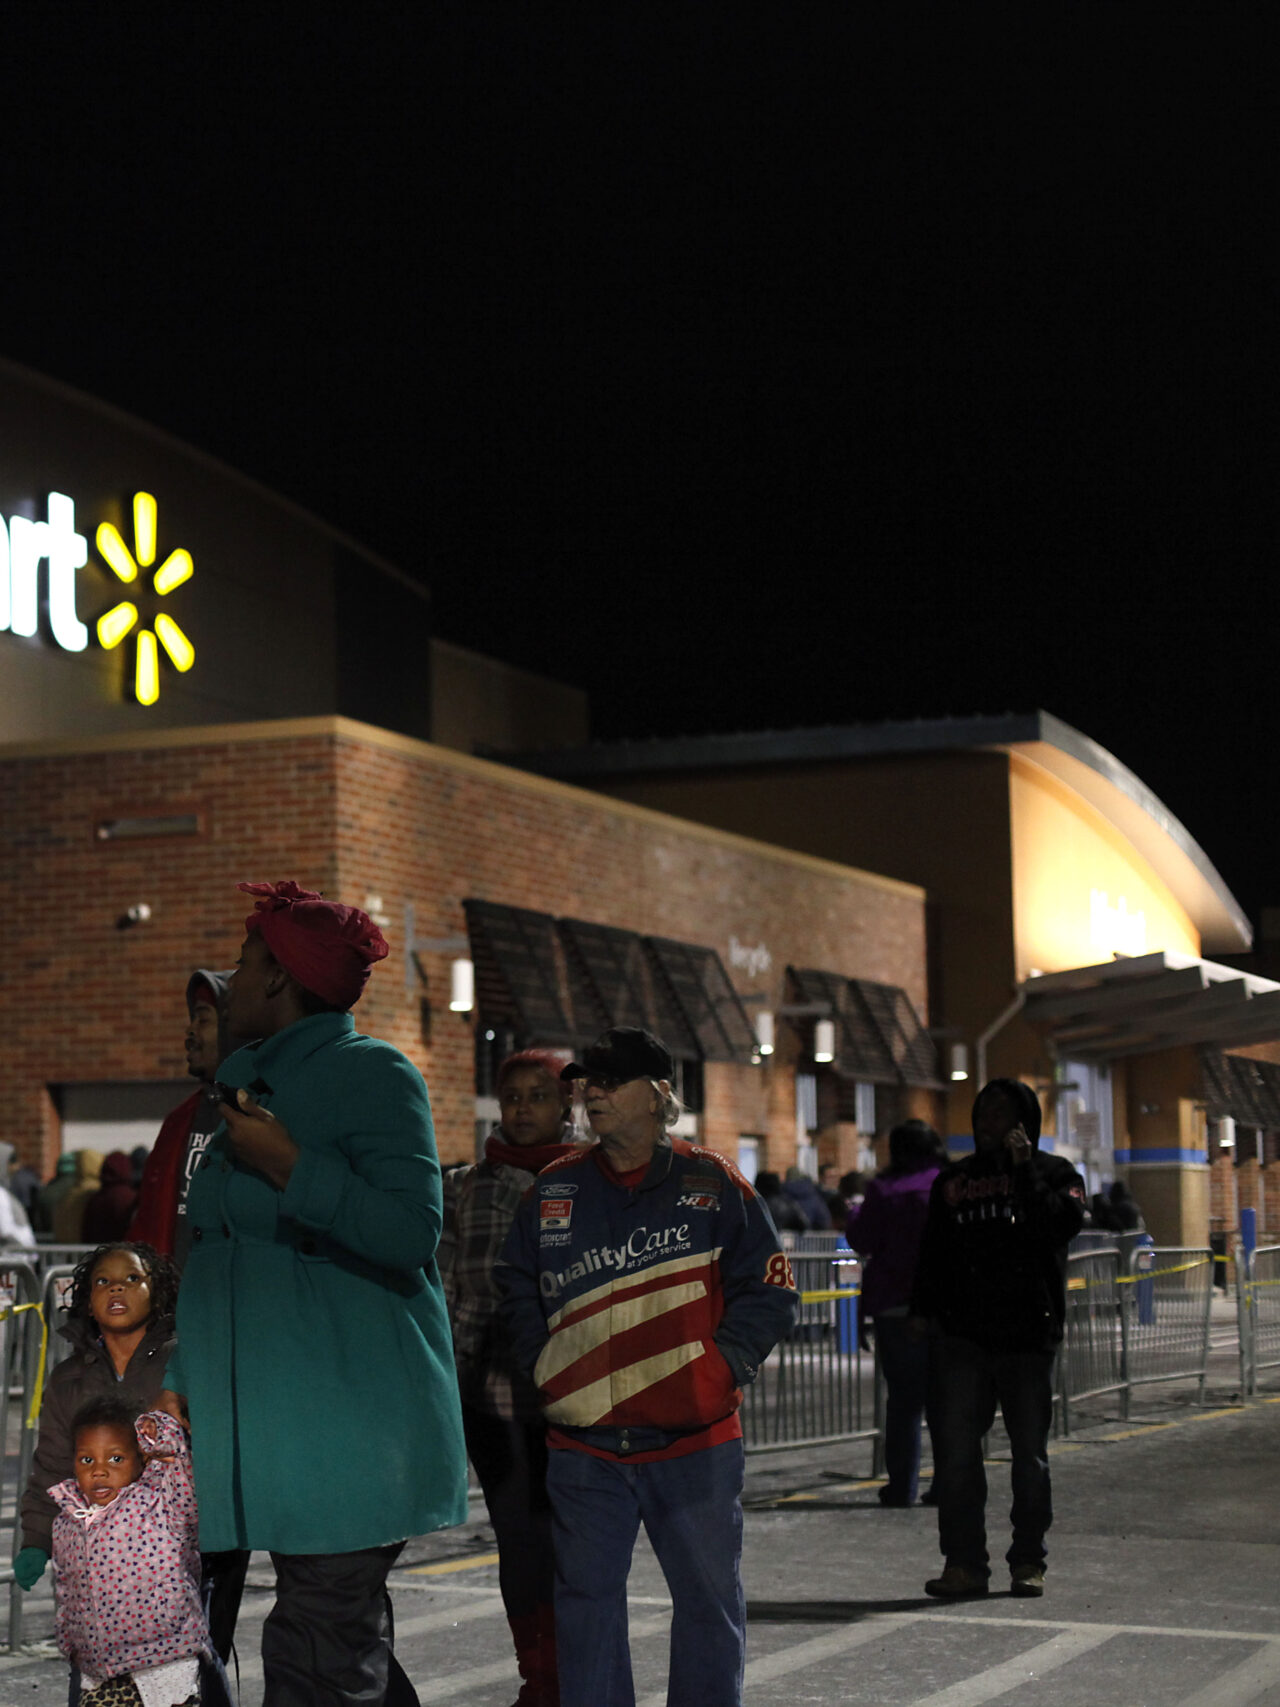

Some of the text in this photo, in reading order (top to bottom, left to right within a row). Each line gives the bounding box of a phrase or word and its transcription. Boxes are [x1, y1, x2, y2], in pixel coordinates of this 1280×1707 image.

[626, 1241, 692, 1269] at your service
